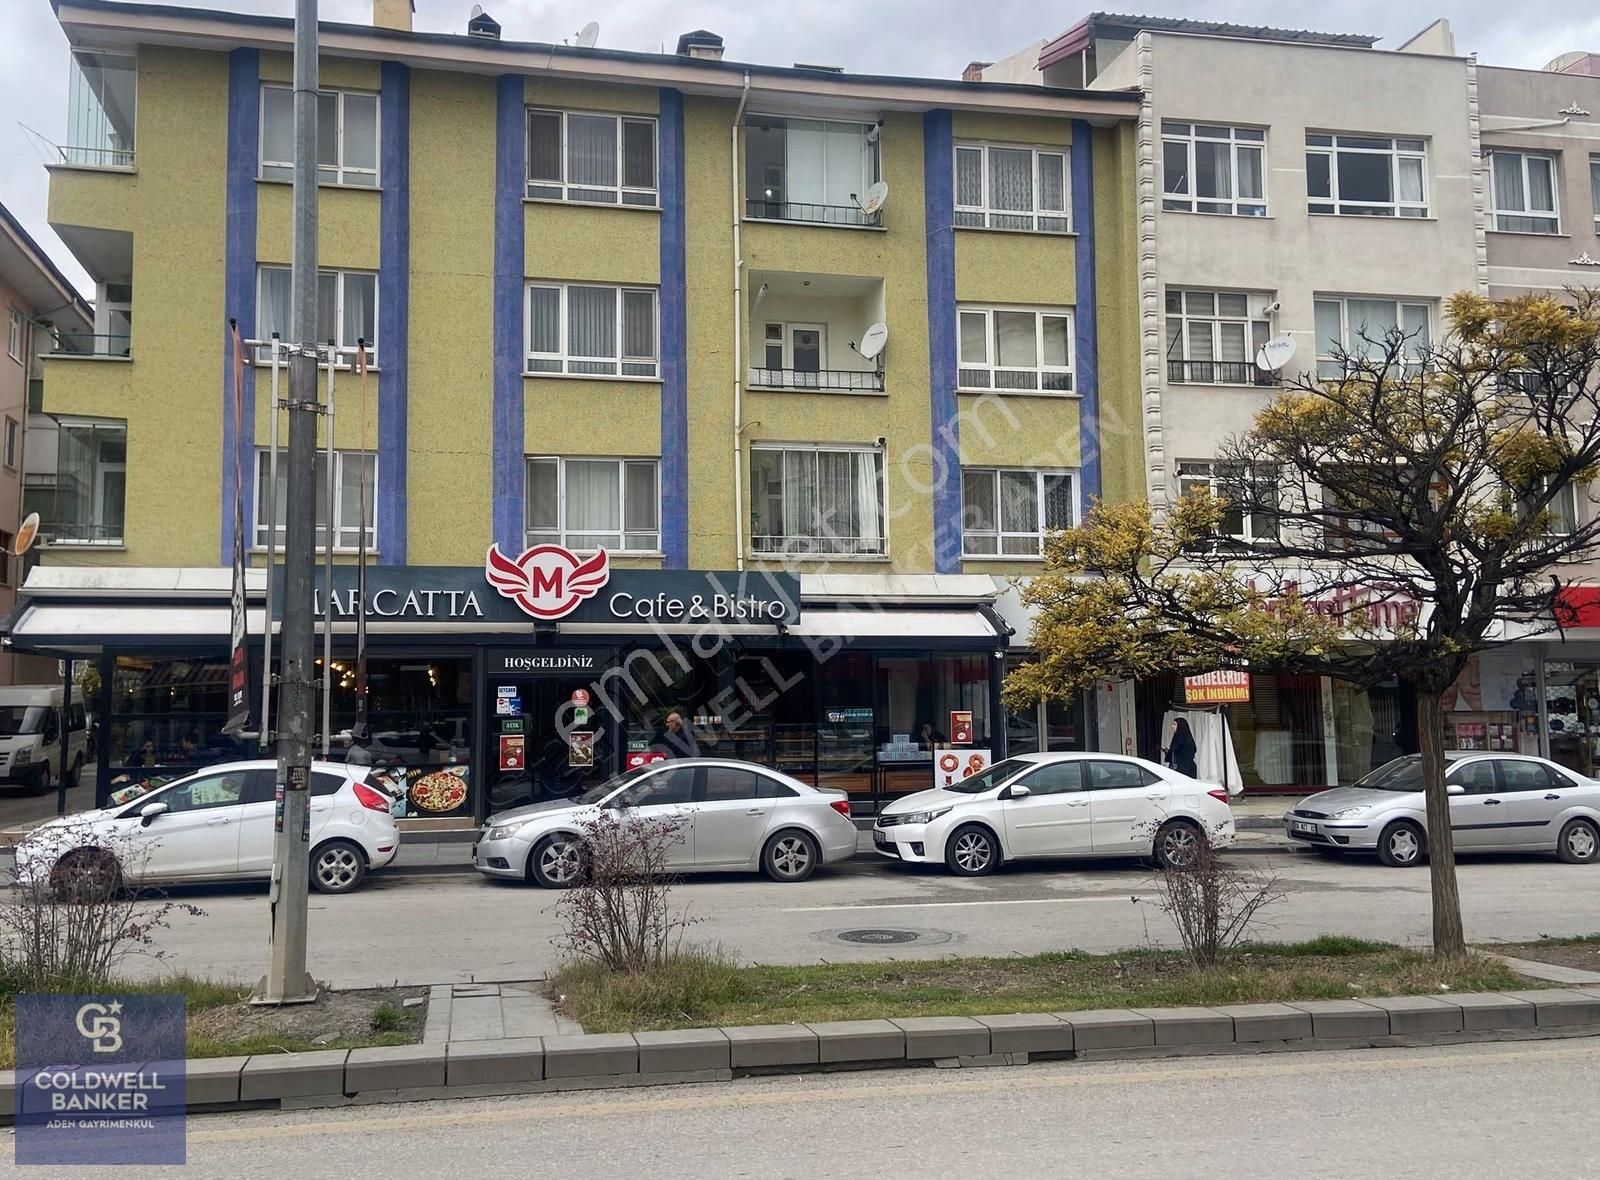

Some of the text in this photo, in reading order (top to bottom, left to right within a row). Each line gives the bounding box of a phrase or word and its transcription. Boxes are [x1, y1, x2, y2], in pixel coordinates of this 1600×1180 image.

[531, 566, 563, 599] M
[504, 654, 593, 670] HOŞGELDİNİZ
[1186, 688, 1205, 703] ŞOK
